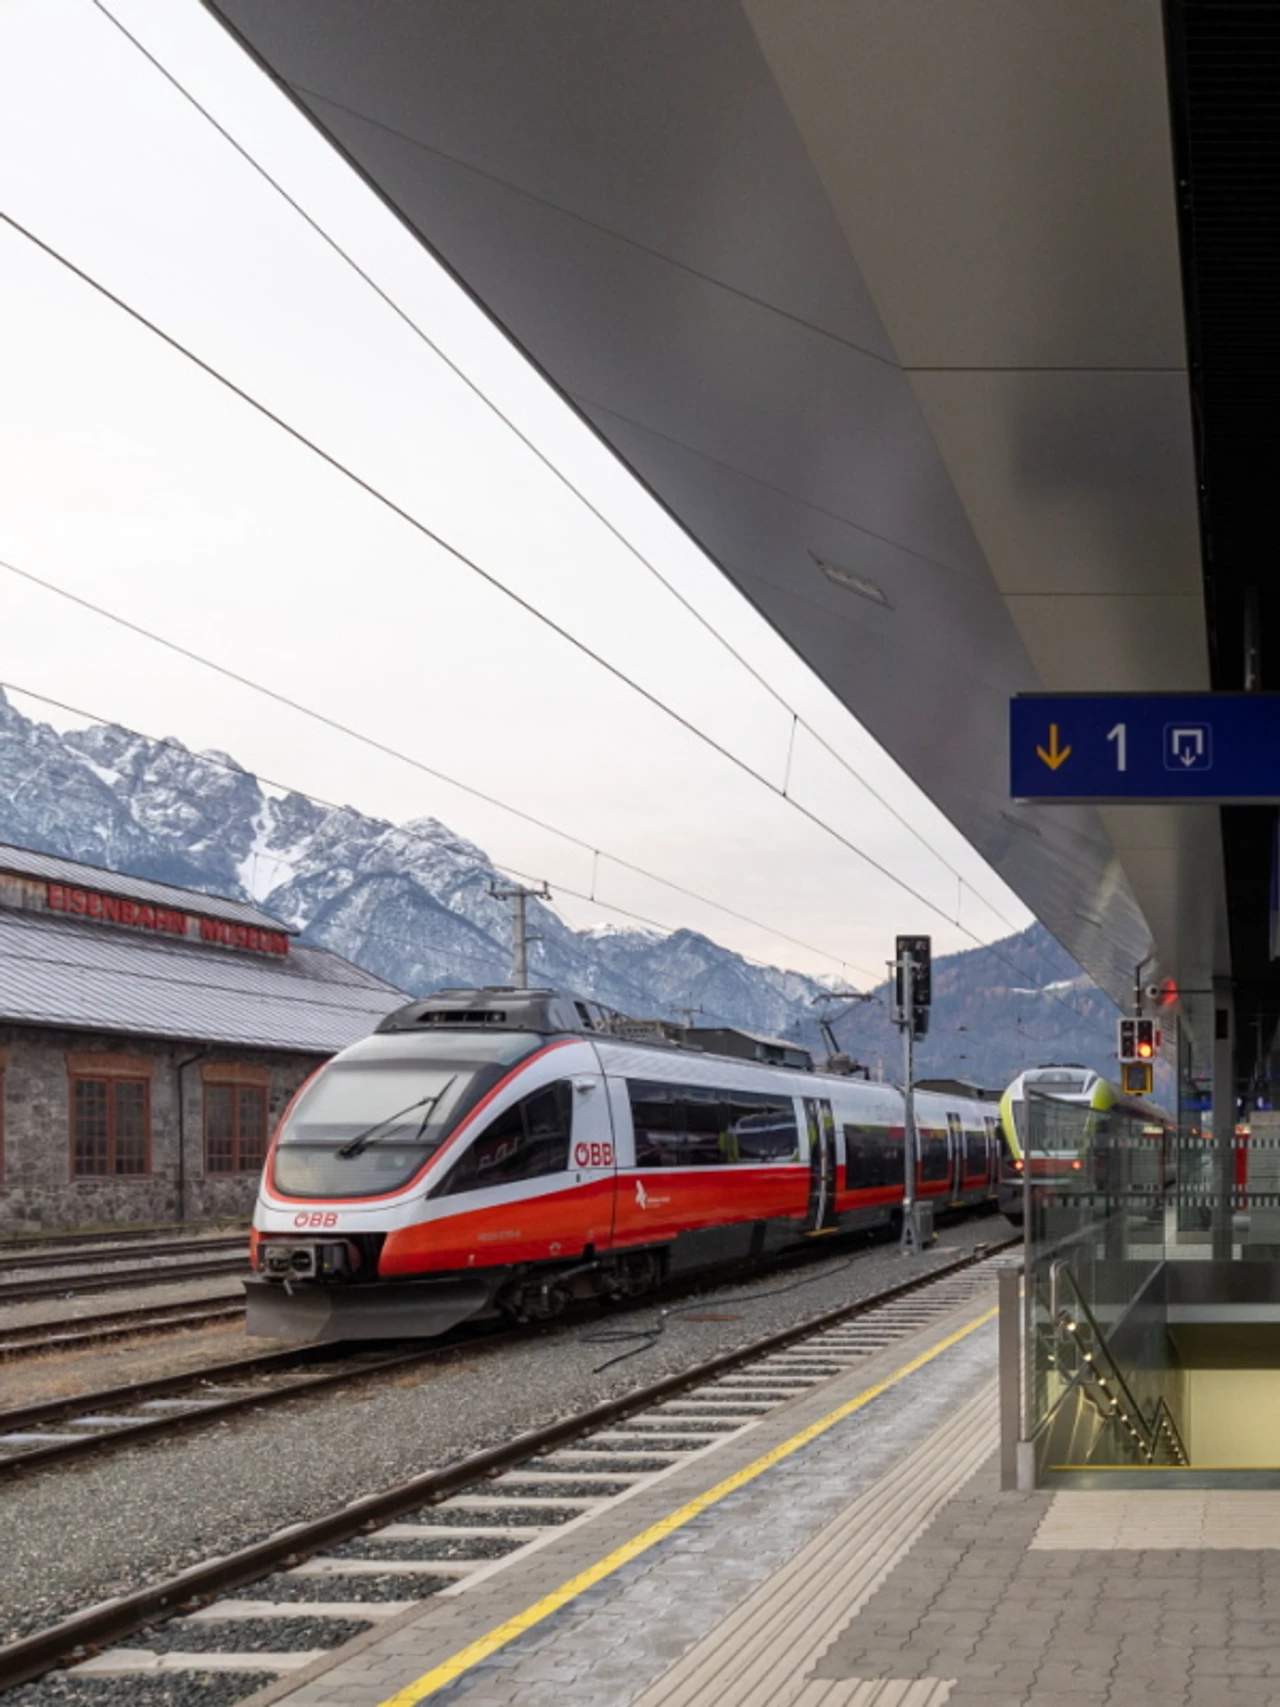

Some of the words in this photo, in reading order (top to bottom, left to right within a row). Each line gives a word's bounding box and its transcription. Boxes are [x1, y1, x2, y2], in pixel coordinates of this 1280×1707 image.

[1106, 723, 1126, 771] 1
[49, 884, 188, 935] EISENBAHN
[201, 918, 289, 955] MUSEUM
